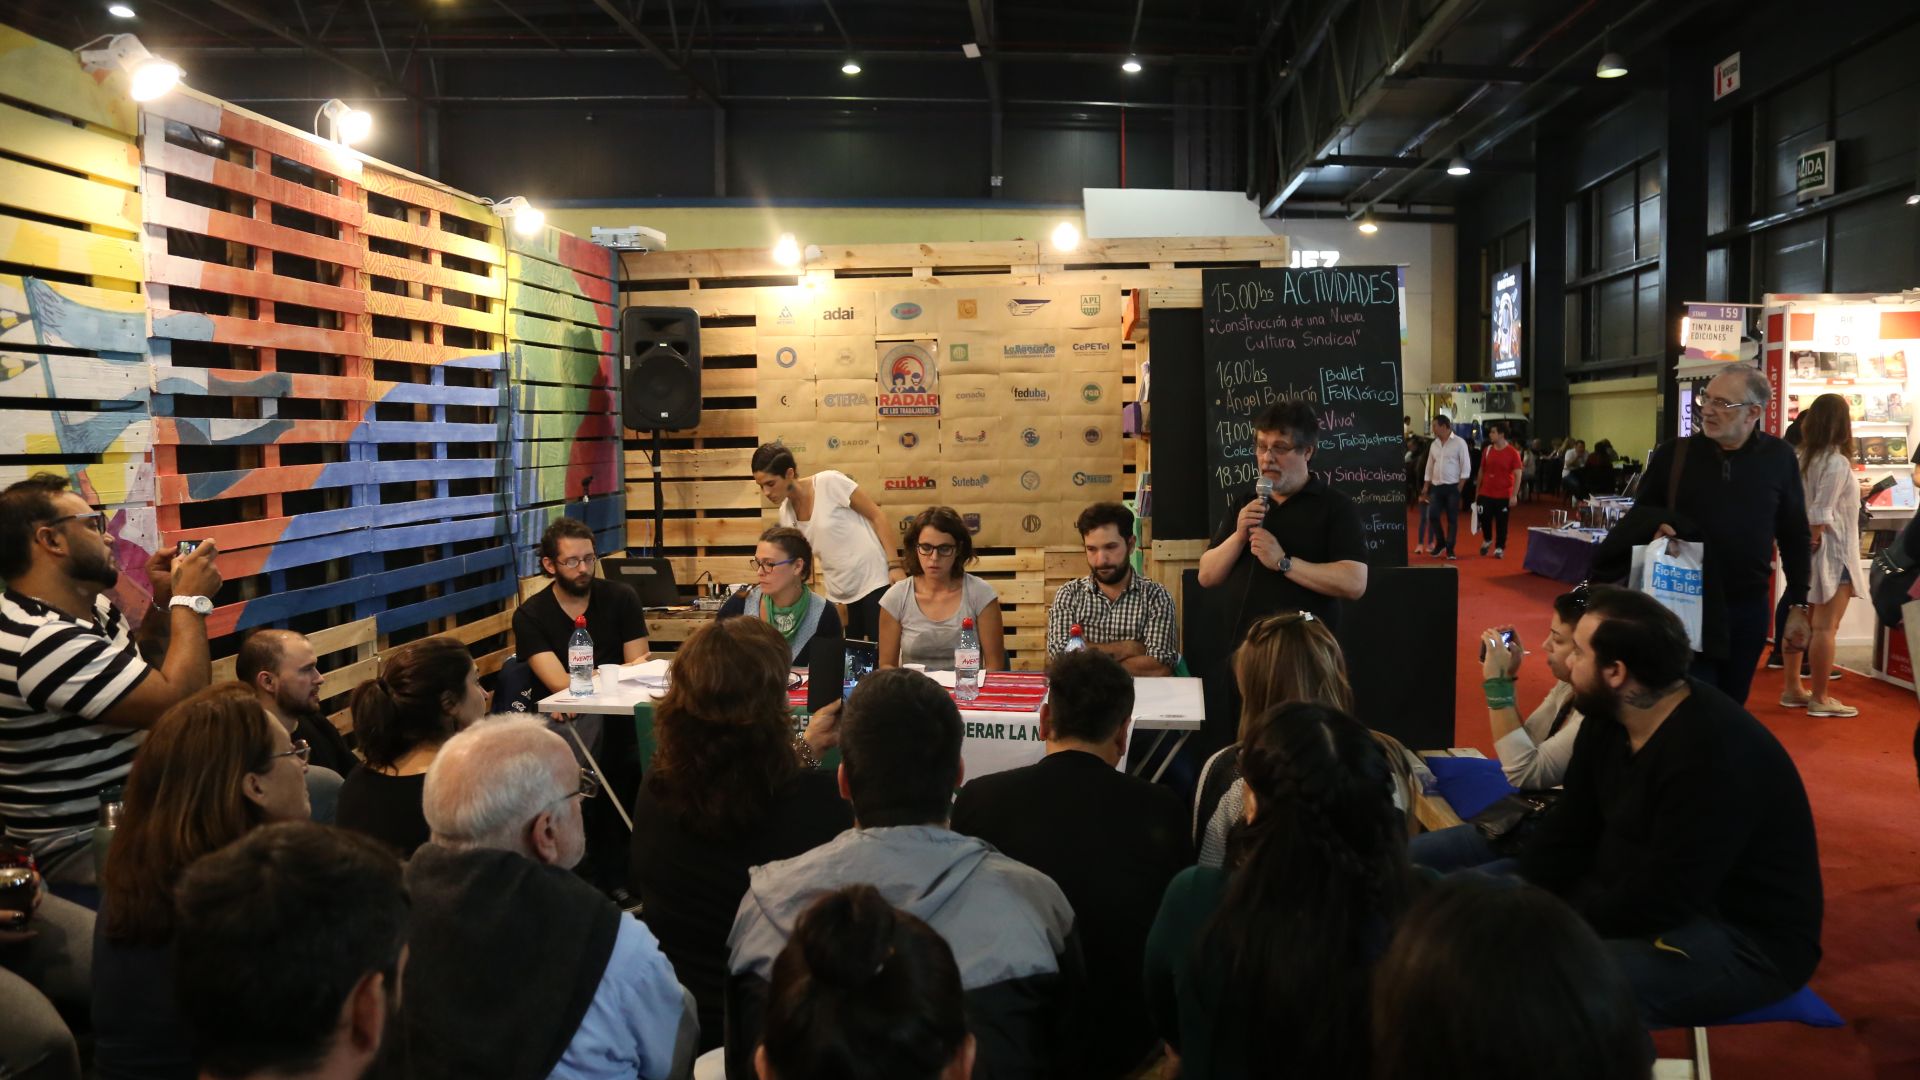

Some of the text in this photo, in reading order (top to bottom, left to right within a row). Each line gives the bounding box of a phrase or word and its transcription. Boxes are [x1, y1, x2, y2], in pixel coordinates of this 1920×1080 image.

[1082, 296, 1098, 304] APL
[1211, 281, 1275, 313] 15.00hs
[823, 307, 854, 320] adai
[1291, 316, 1304, 328] de
[1307, 317, 1325, 327] una
[1330, 306, 1365, 325] Nueva
[1720, 307, 1738, 319] 159
[1692, 323, 1734, 333] TINTA LIBRE
[1690, 332, 1727, 341] EDICIONES
[1072, 343, 1110, 351] CePETel
[1245, 335, 1296, 352] Cultura
[879, 394, 938, 406] RADAR
[1009, 725, 1027, 741] LA
